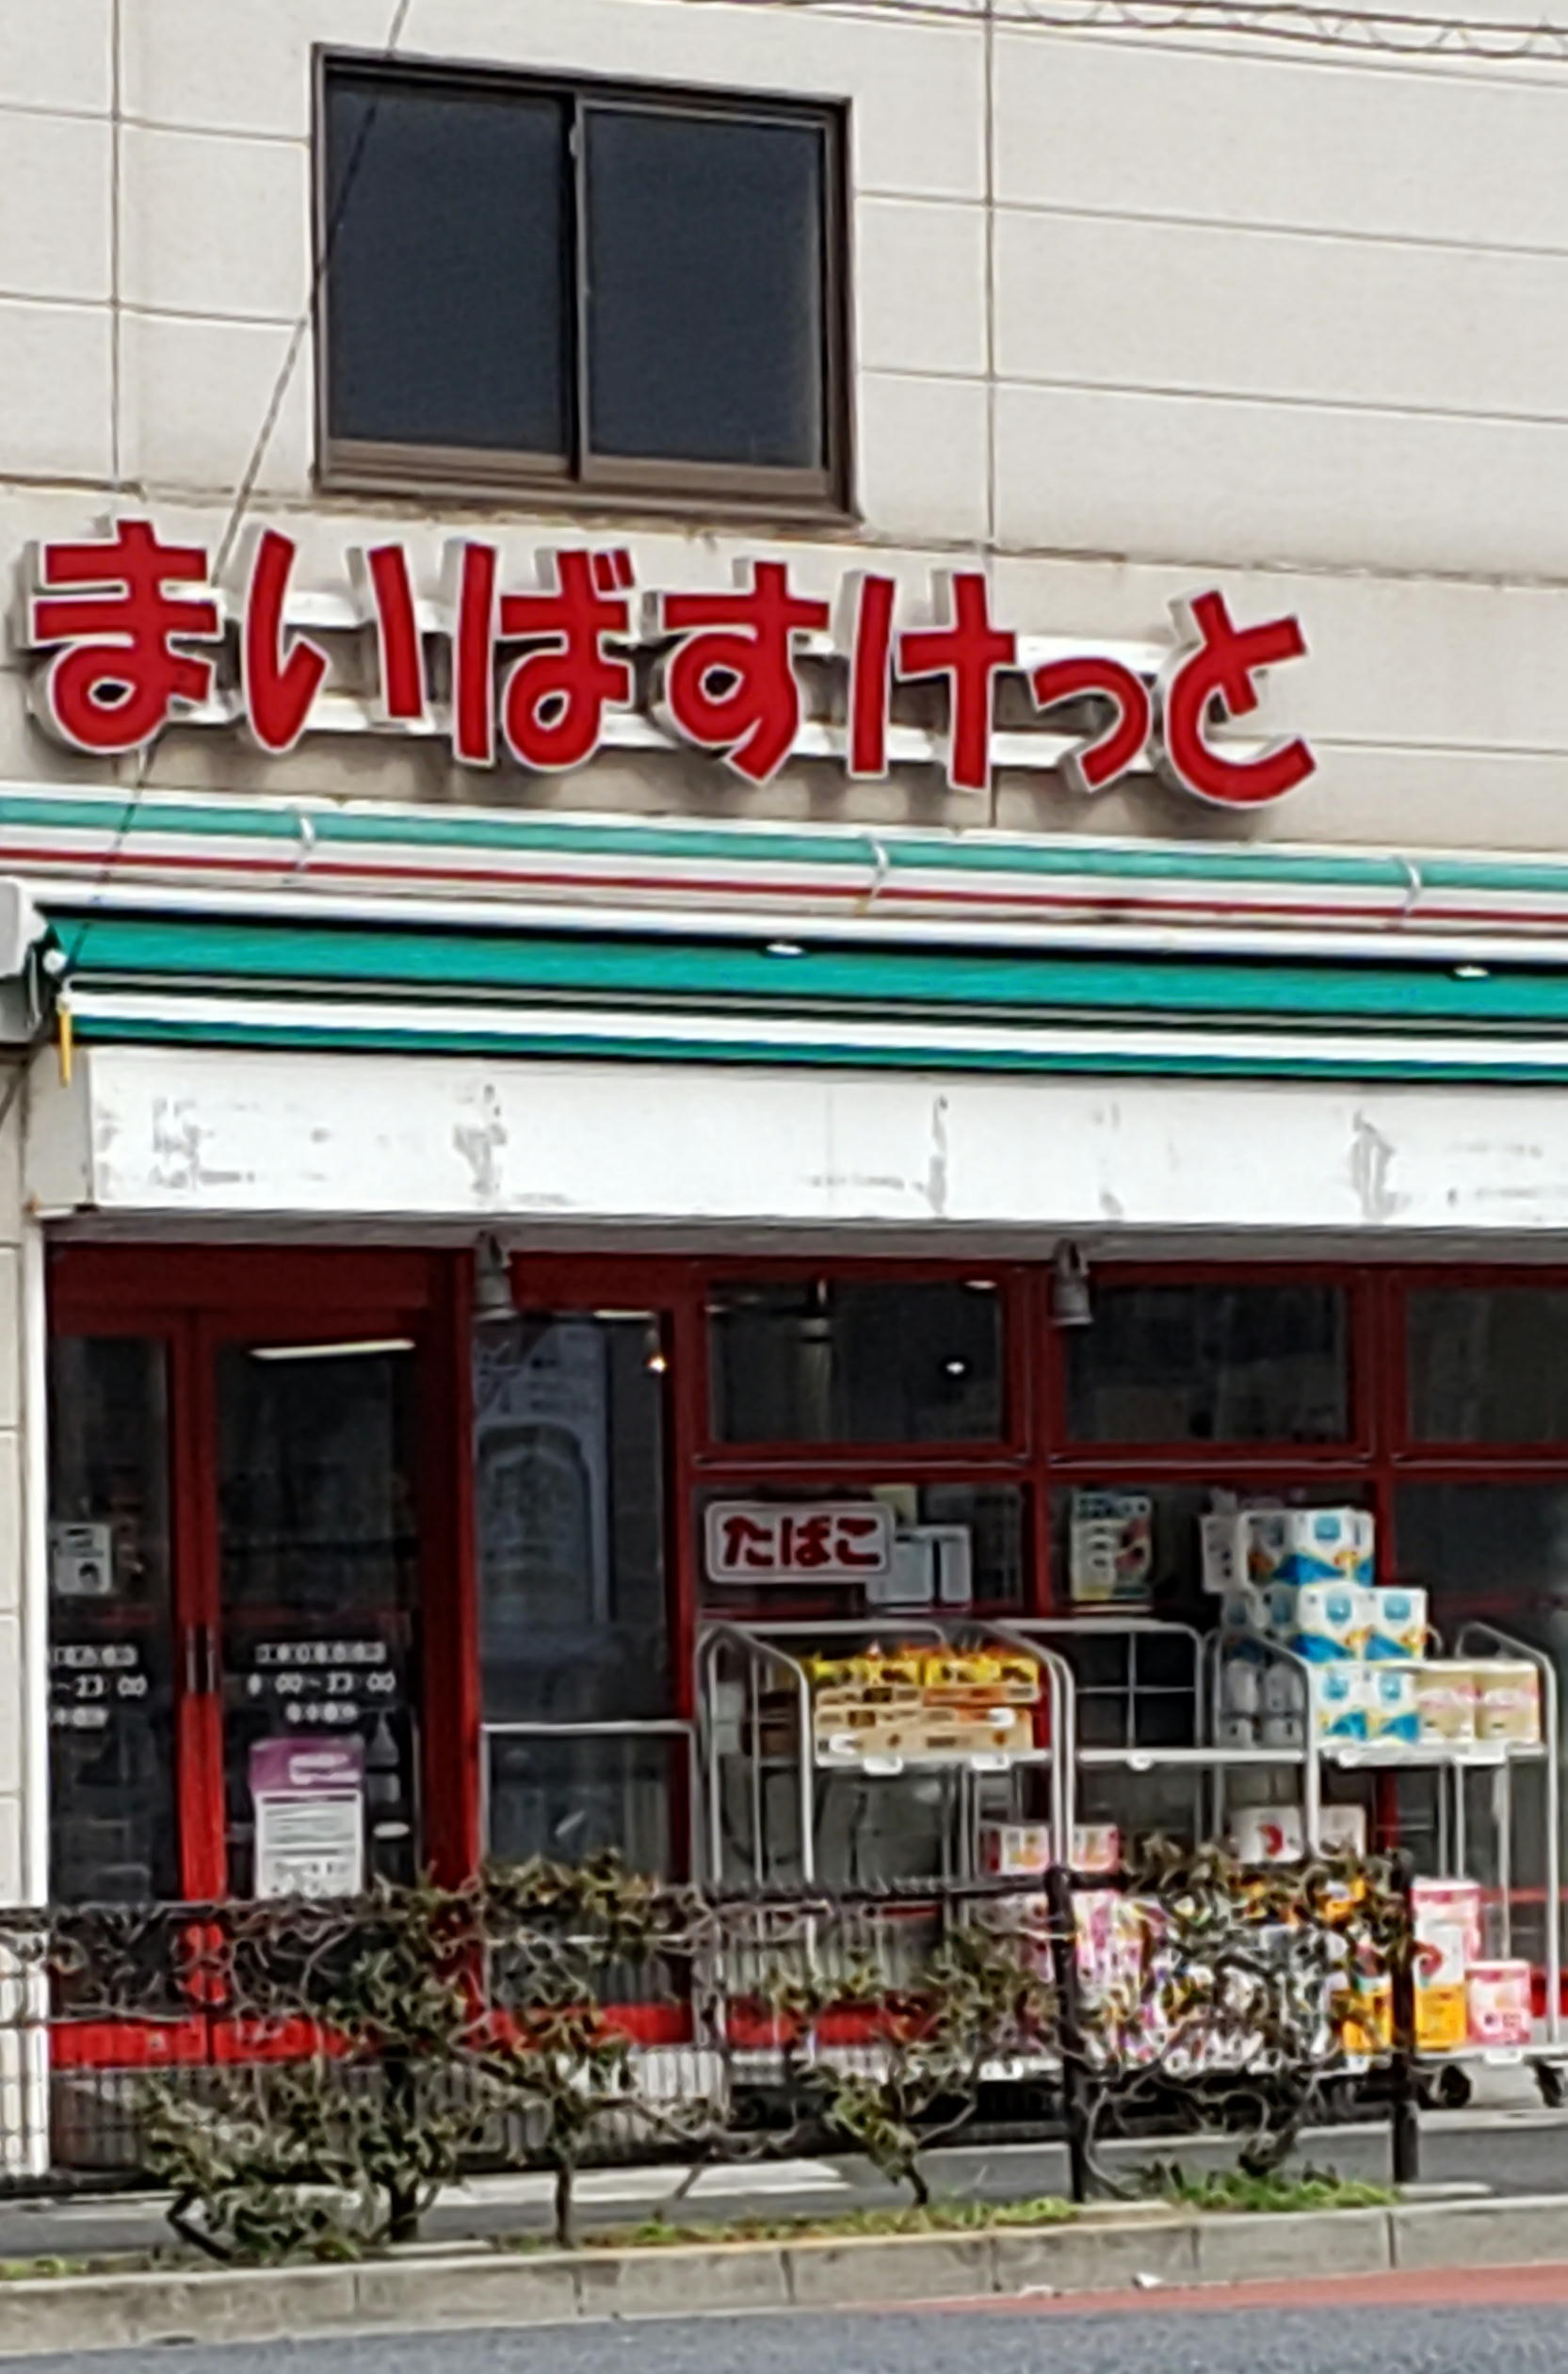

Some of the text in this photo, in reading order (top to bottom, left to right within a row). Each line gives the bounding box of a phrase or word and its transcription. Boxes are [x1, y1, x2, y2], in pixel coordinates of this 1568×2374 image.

[32, 518, 1317, 808] まいばすけっと
[723, 1515, 881, 1567] たばこ
